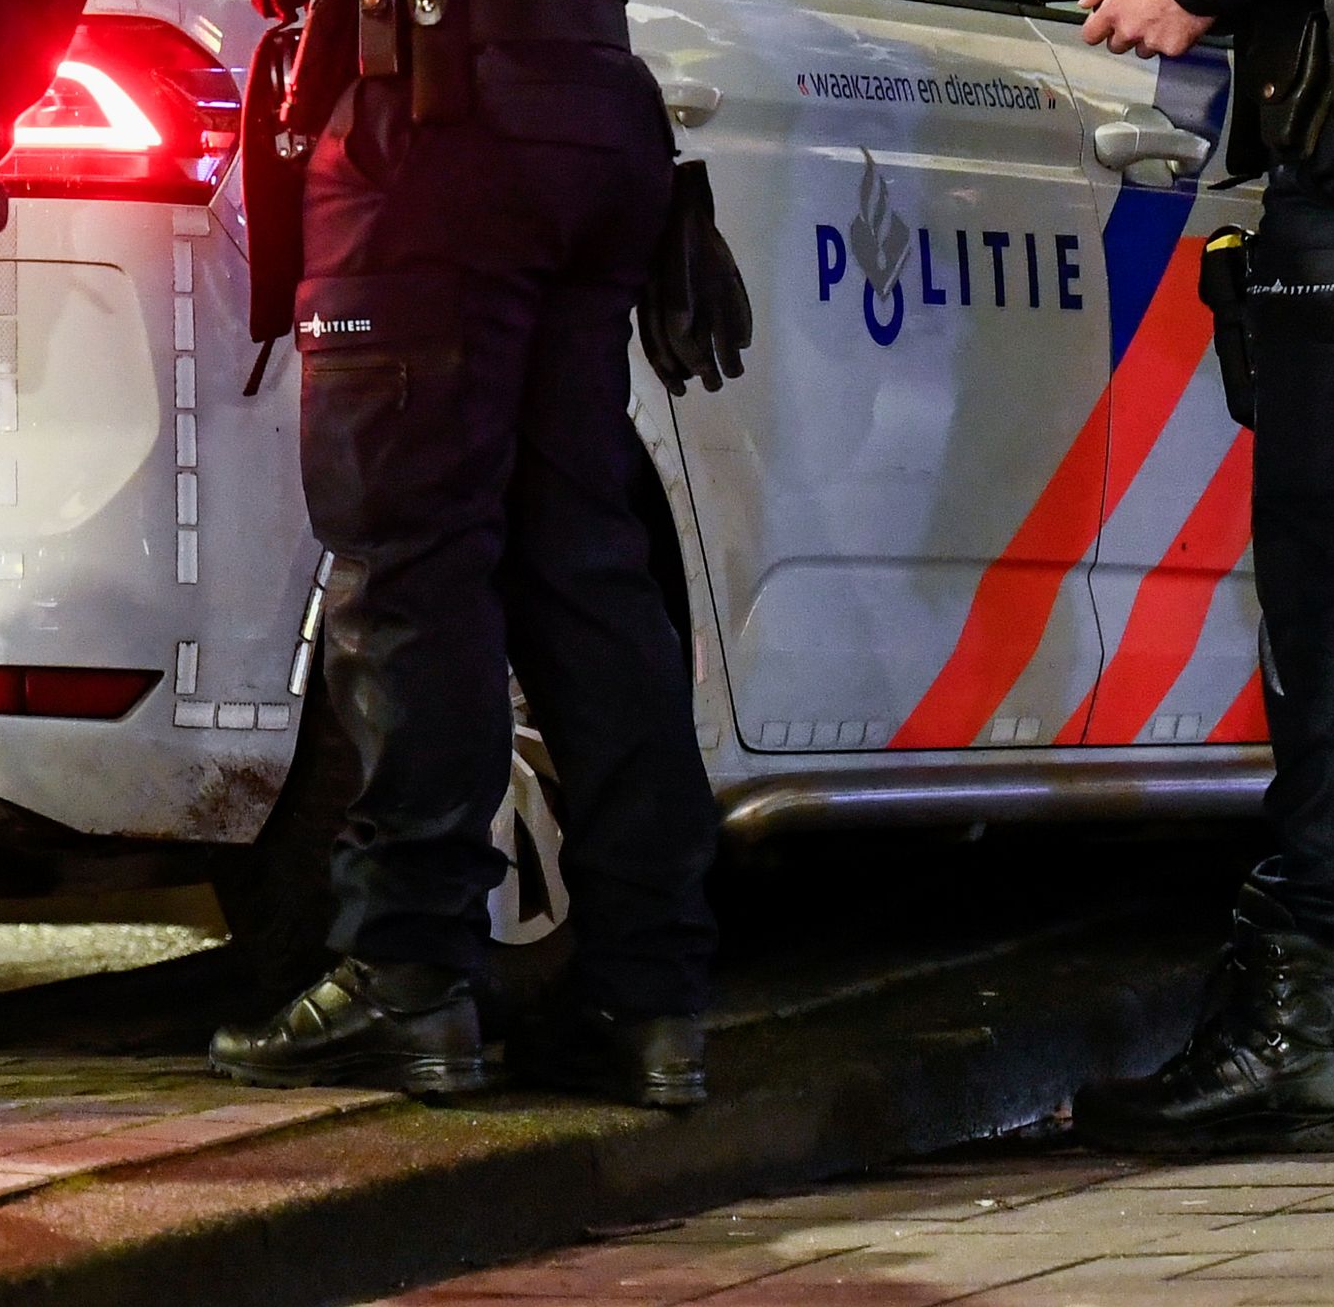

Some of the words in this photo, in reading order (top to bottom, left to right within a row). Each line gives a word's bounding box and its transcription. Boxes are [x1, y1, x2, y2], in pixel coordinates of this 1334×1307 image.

[810, 72, 915, 103] waakzaam
[917, 78, 941, 105] en
[944, 75, 1042, 110] dienstbaar
[816, 223, 1083, 347] POLITIE
